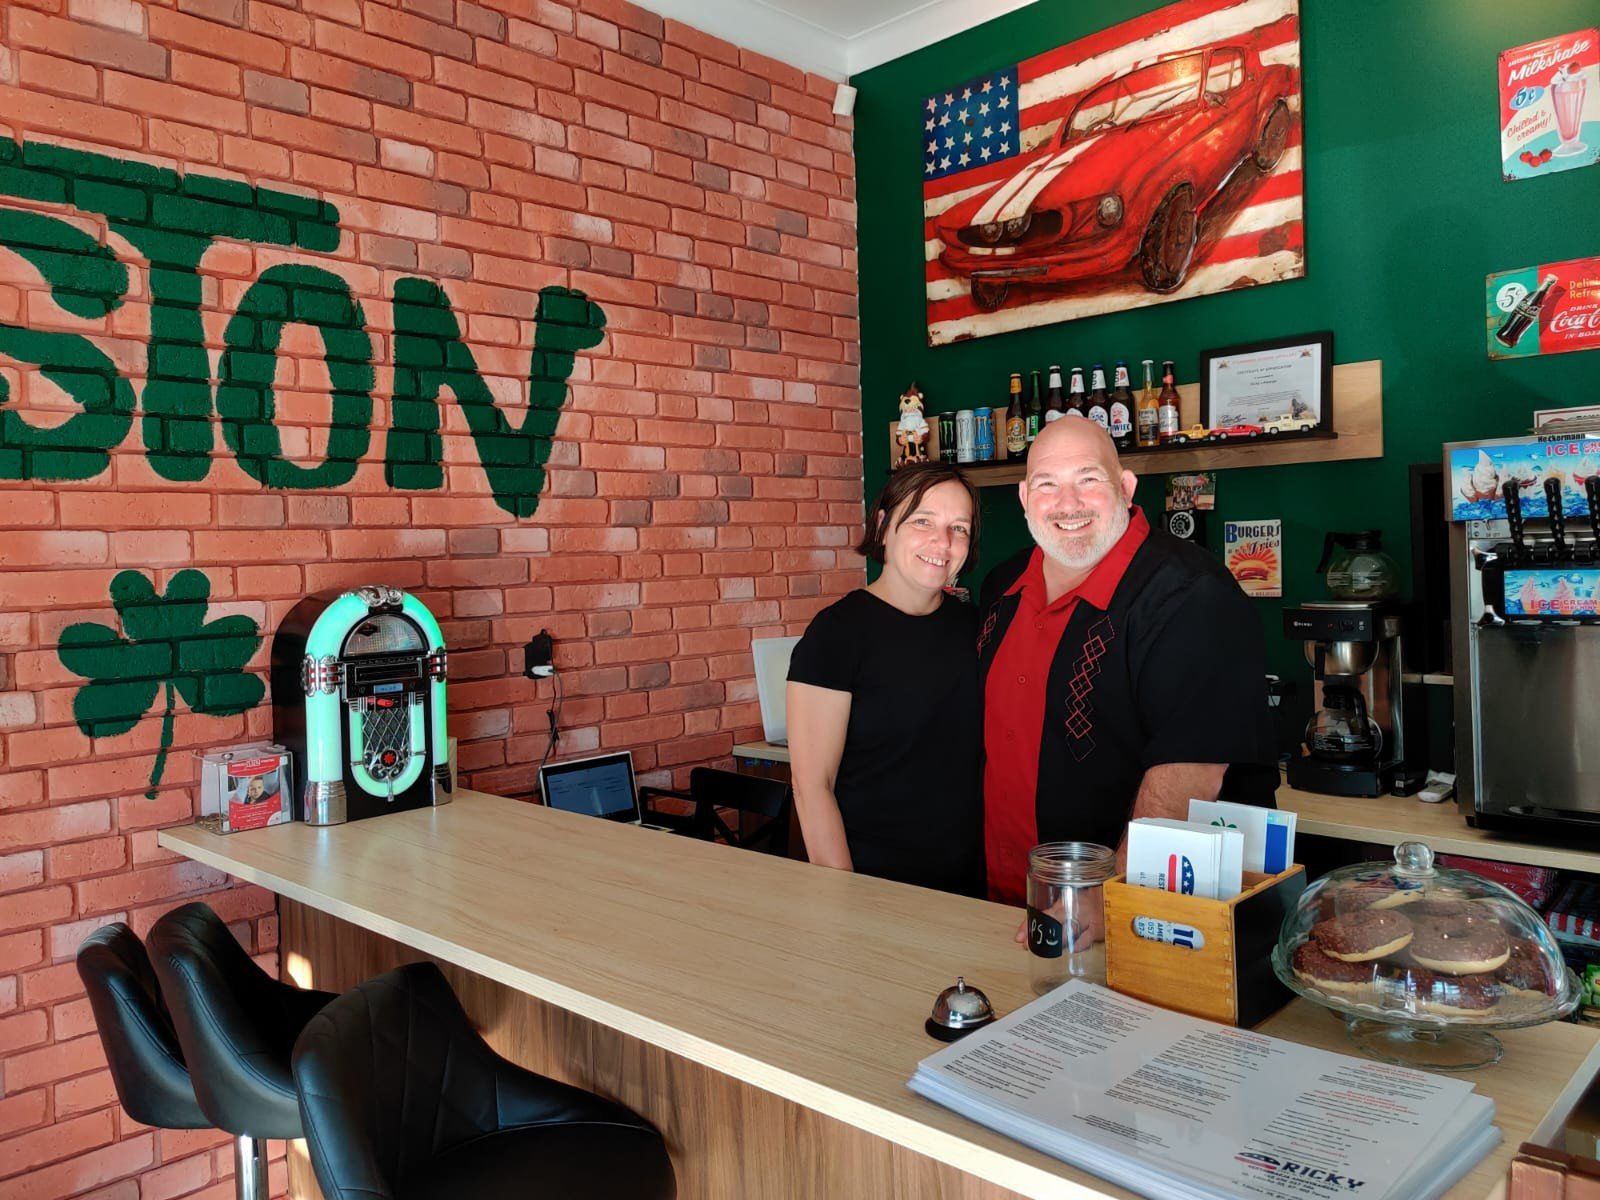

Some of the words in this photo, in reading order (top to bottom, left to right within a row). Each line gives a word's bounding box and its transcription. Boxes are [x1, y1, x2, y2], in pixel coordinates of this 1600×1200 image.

[1507, 39, 1591, 87] Milkshake
[1507, 111, 1539, 139] Chilled
[1570, 303, 1598, 312] DRINK
[1545, 443, 1579, 458] ICE
[1225, 523, 1280, 543] BURGERS
[1249, 538, 1280, 555] Fries
[1530, 599, 1561, 610] ICE
[1281, 1161, 1366, 1189] RICKY
